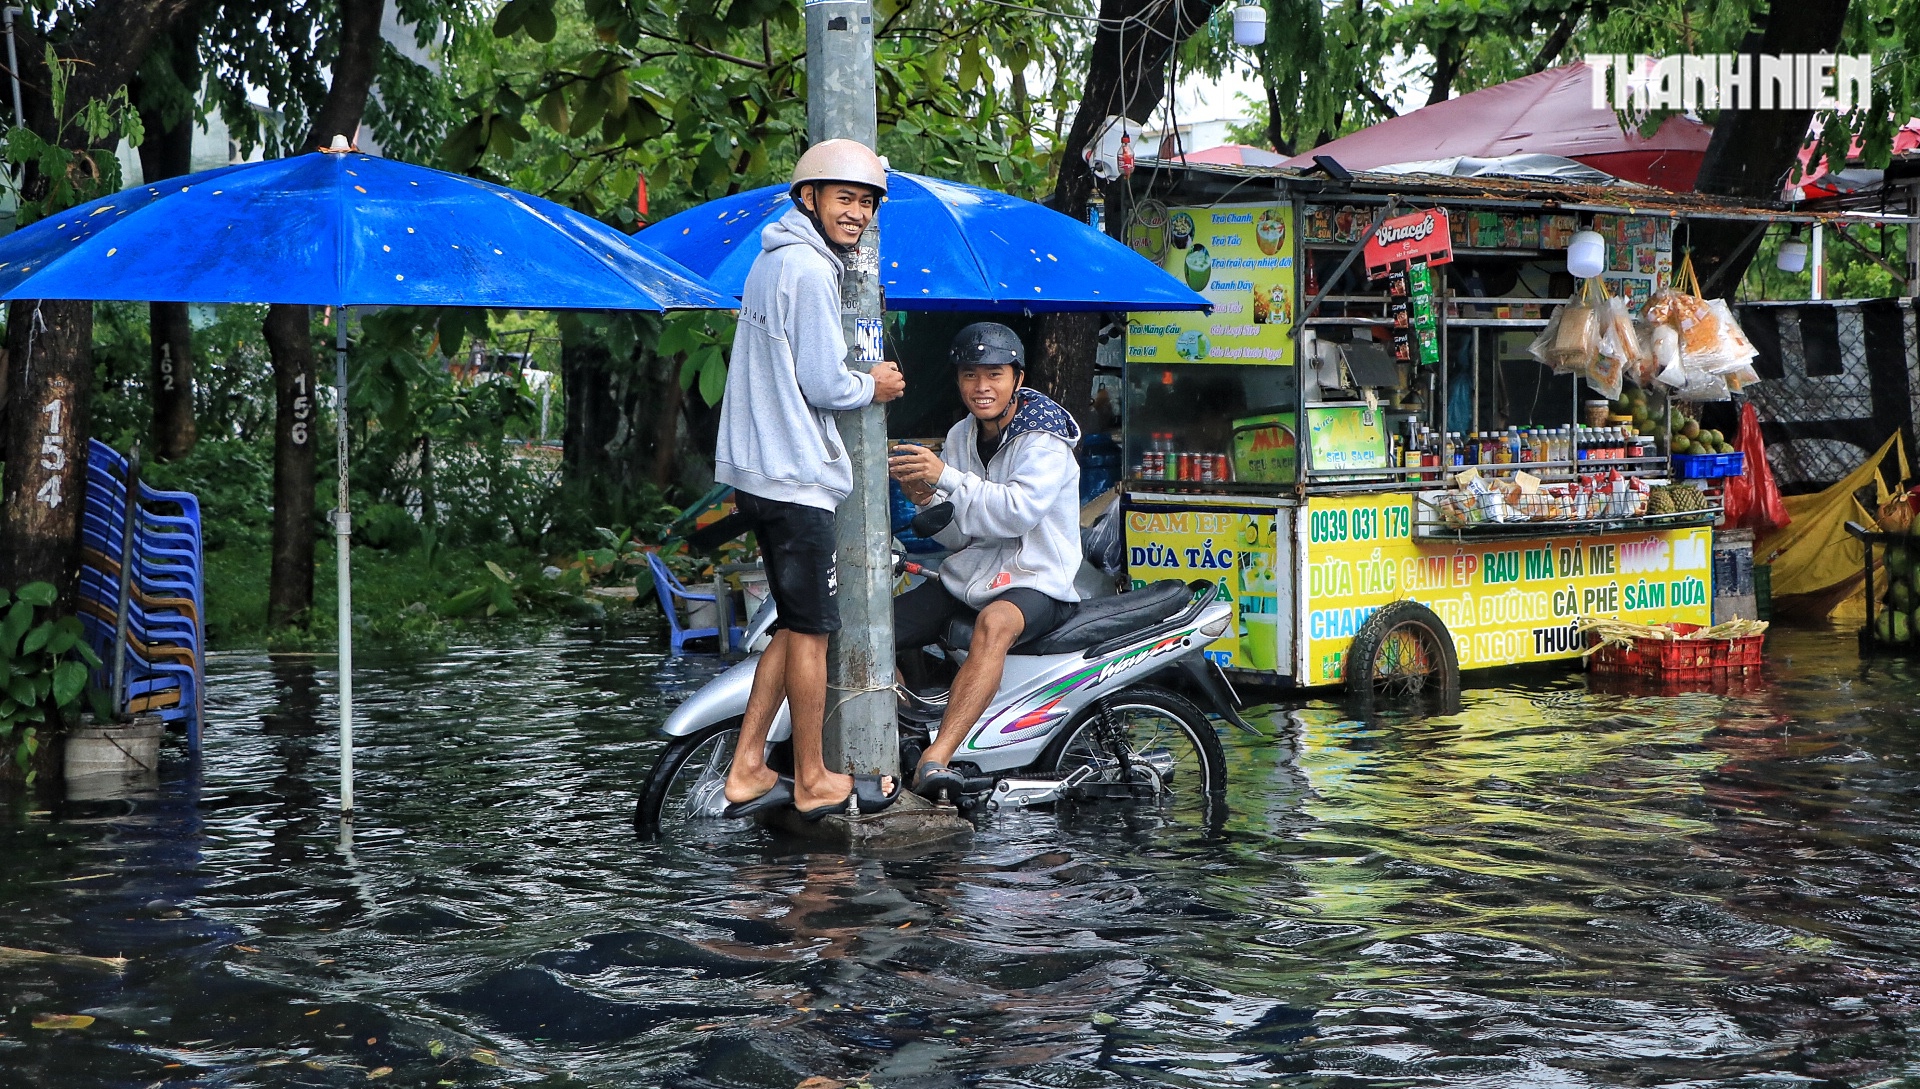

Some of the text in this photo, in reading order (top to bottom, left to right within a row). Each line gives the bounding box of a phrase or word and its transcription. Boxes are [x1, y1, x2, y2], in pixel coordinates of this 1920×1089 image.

[1226, 212, 1253, 225] Chanh
[1375, 213, 1435, 247] Vinacafé
[1210, 280, 1236, 291] Chanh
[160, 342, 174, 391] 162
[291, 373, 311, 445] 156
[36, 398, 66, 509] 154
[1129, 513, 1189, 534] CAM
[1311, 506, 1410, 543] 0939 031 179
[1130, 539, 1233, 569] DỪA TẮC
[1310, 554, 1352, 598] DỪA
[1357, 551, 1396, 594] TẮC
[1401, 555, 1446, 592] CAM
[1452, 548, 1478, 587] ÉP
[1483, 550, 1519, 584] RAU
[1524, 542, 1555, 580] MÁ
[1559, 541, 1584, 578] ĐÁ
[1589, 543, 1615, 576] ME
[1436, 597, 1472, 627] TRÀ
[1479, 588, 1548, 626] ĐƯỜNG
[1553, 584, 1577, 618] CÀ
[1584, 581, 1619, 614] PHÊ
[1624, 579, 1665, 611] SÂM
[1671, 576, 1706, 607] DỨA
[1474, 629, 1529, 664] NGỌT
